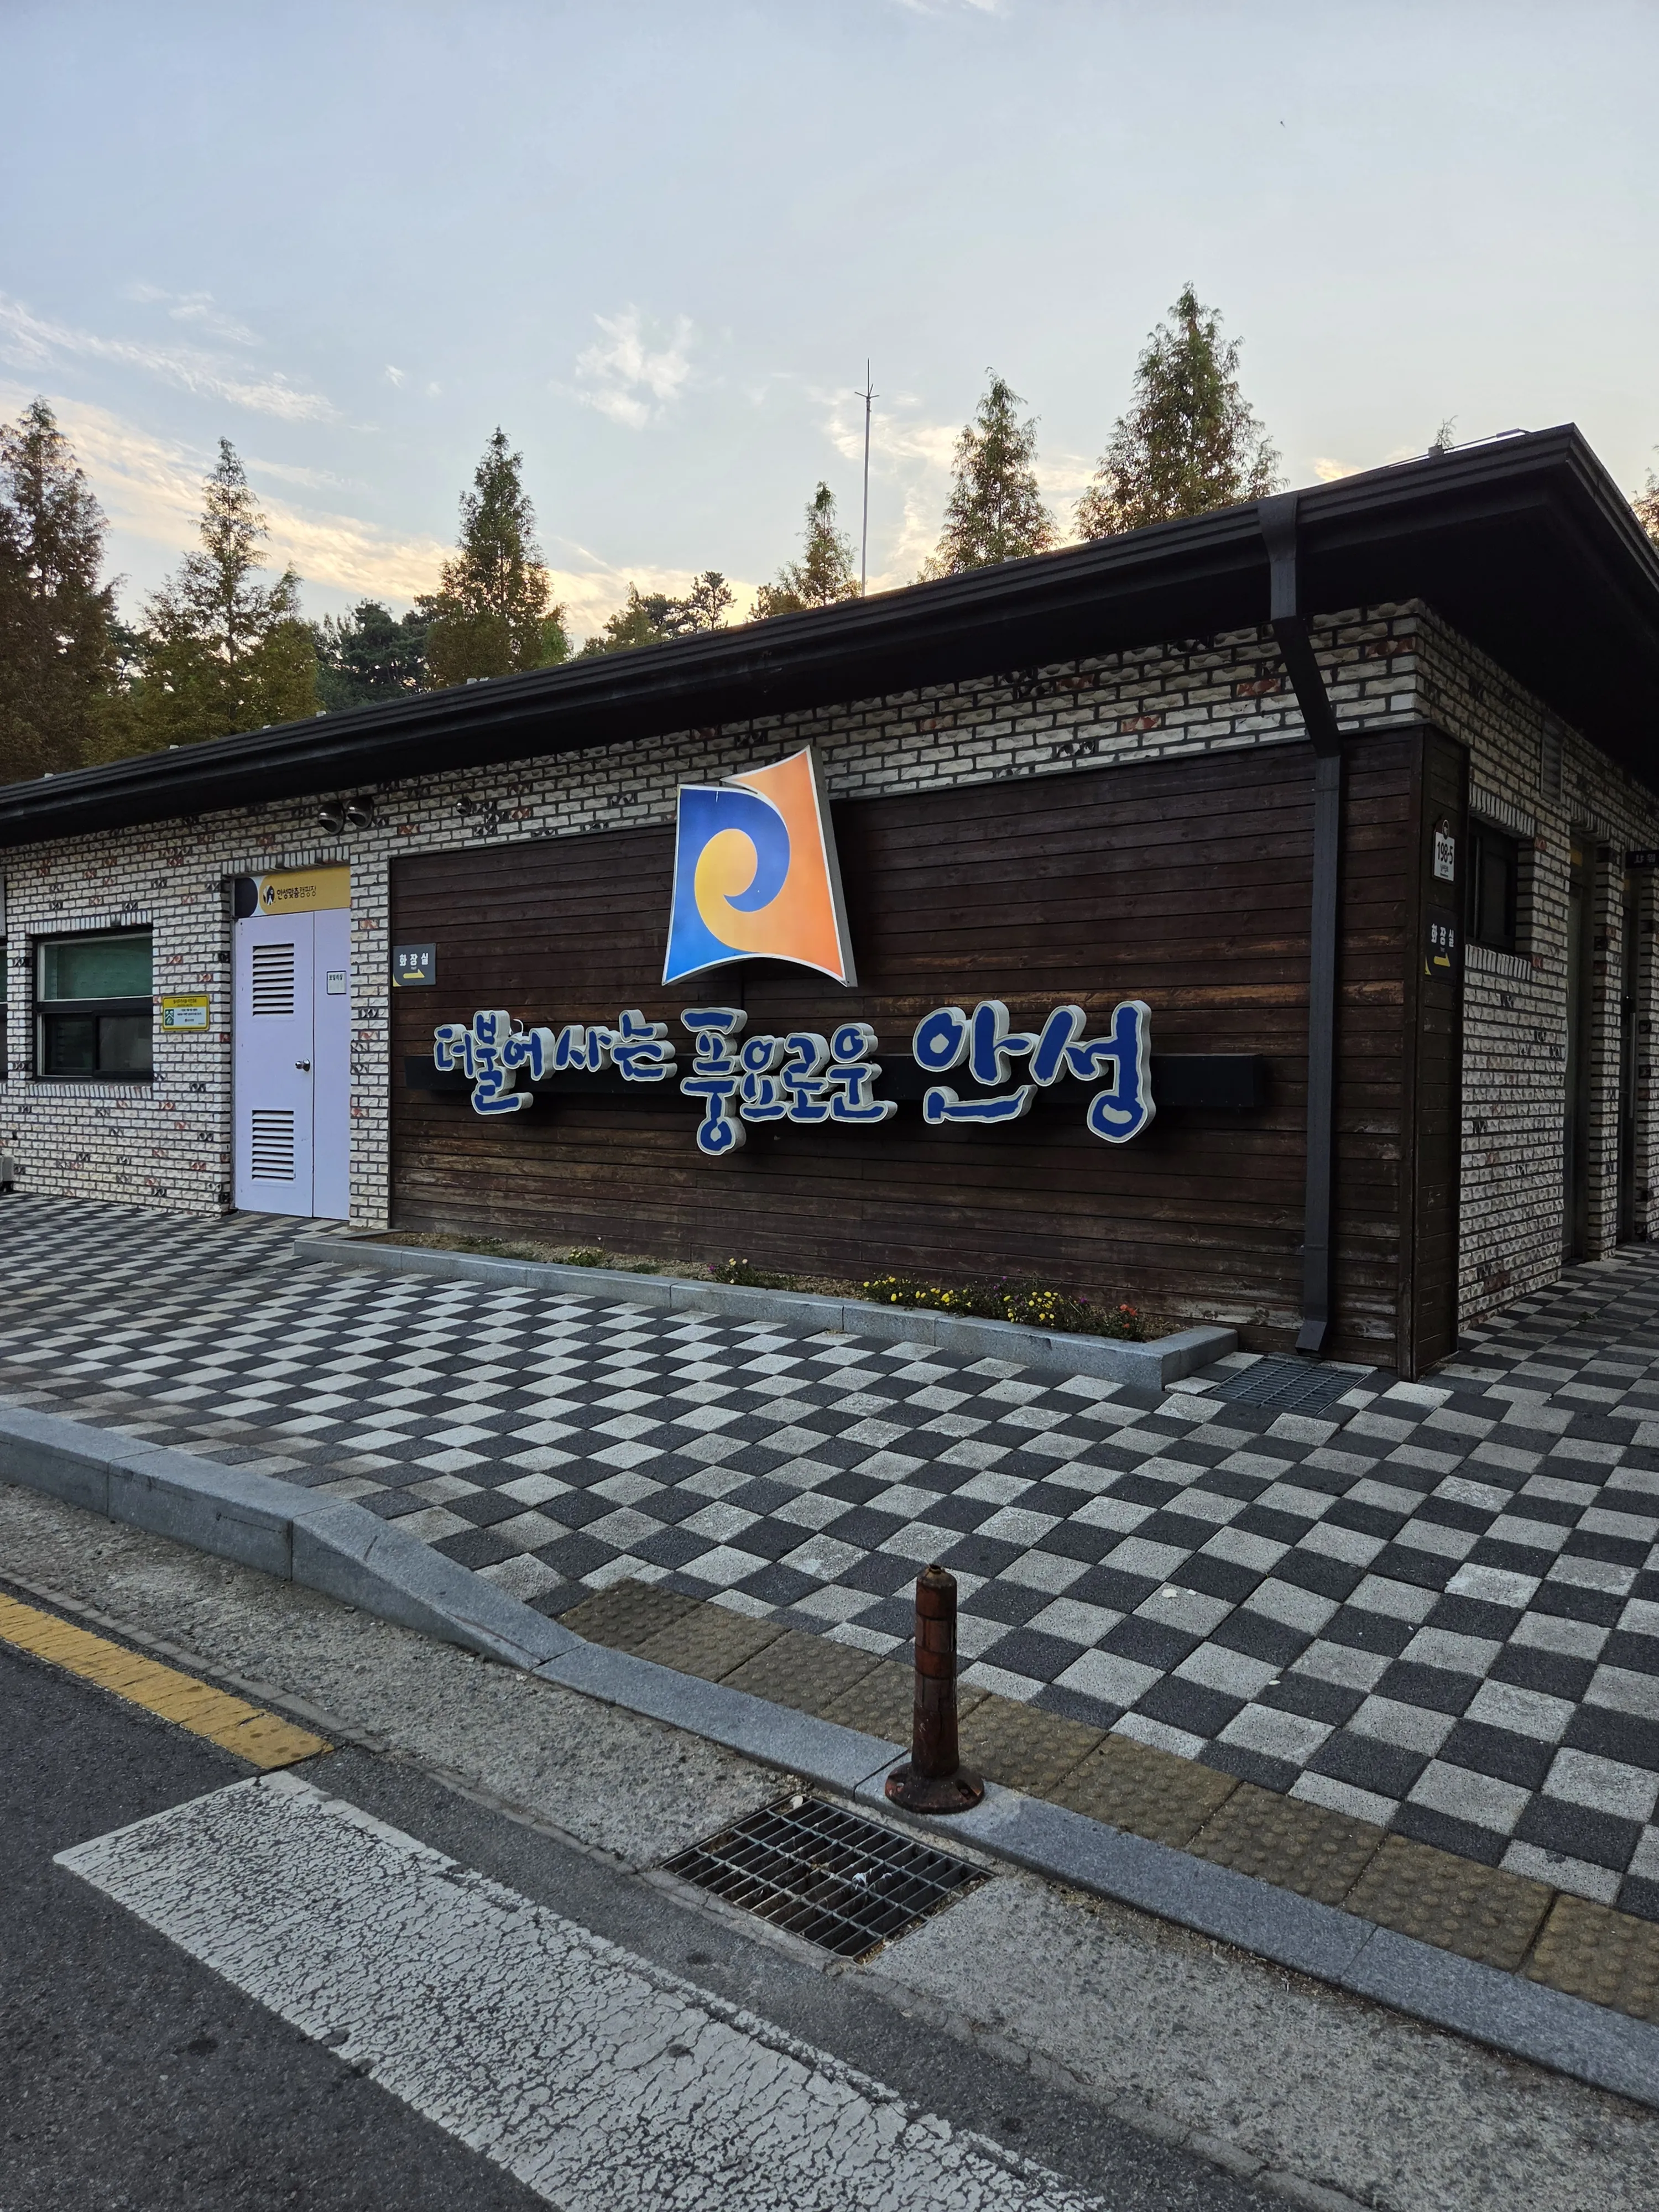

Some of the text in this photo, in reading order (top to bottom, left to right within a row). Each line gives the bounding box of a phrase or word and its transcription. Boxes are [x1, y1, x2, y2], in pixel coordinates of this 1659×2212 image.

[1437, 841, 1453, 865] 198-5
[1431, 923, 1454, 948] 화장실
[399, 952, 429, 966] 화장실
[680, 1007, 898, 1155] 풍요로운
[912, 1000, 1156, 1143] 안성
